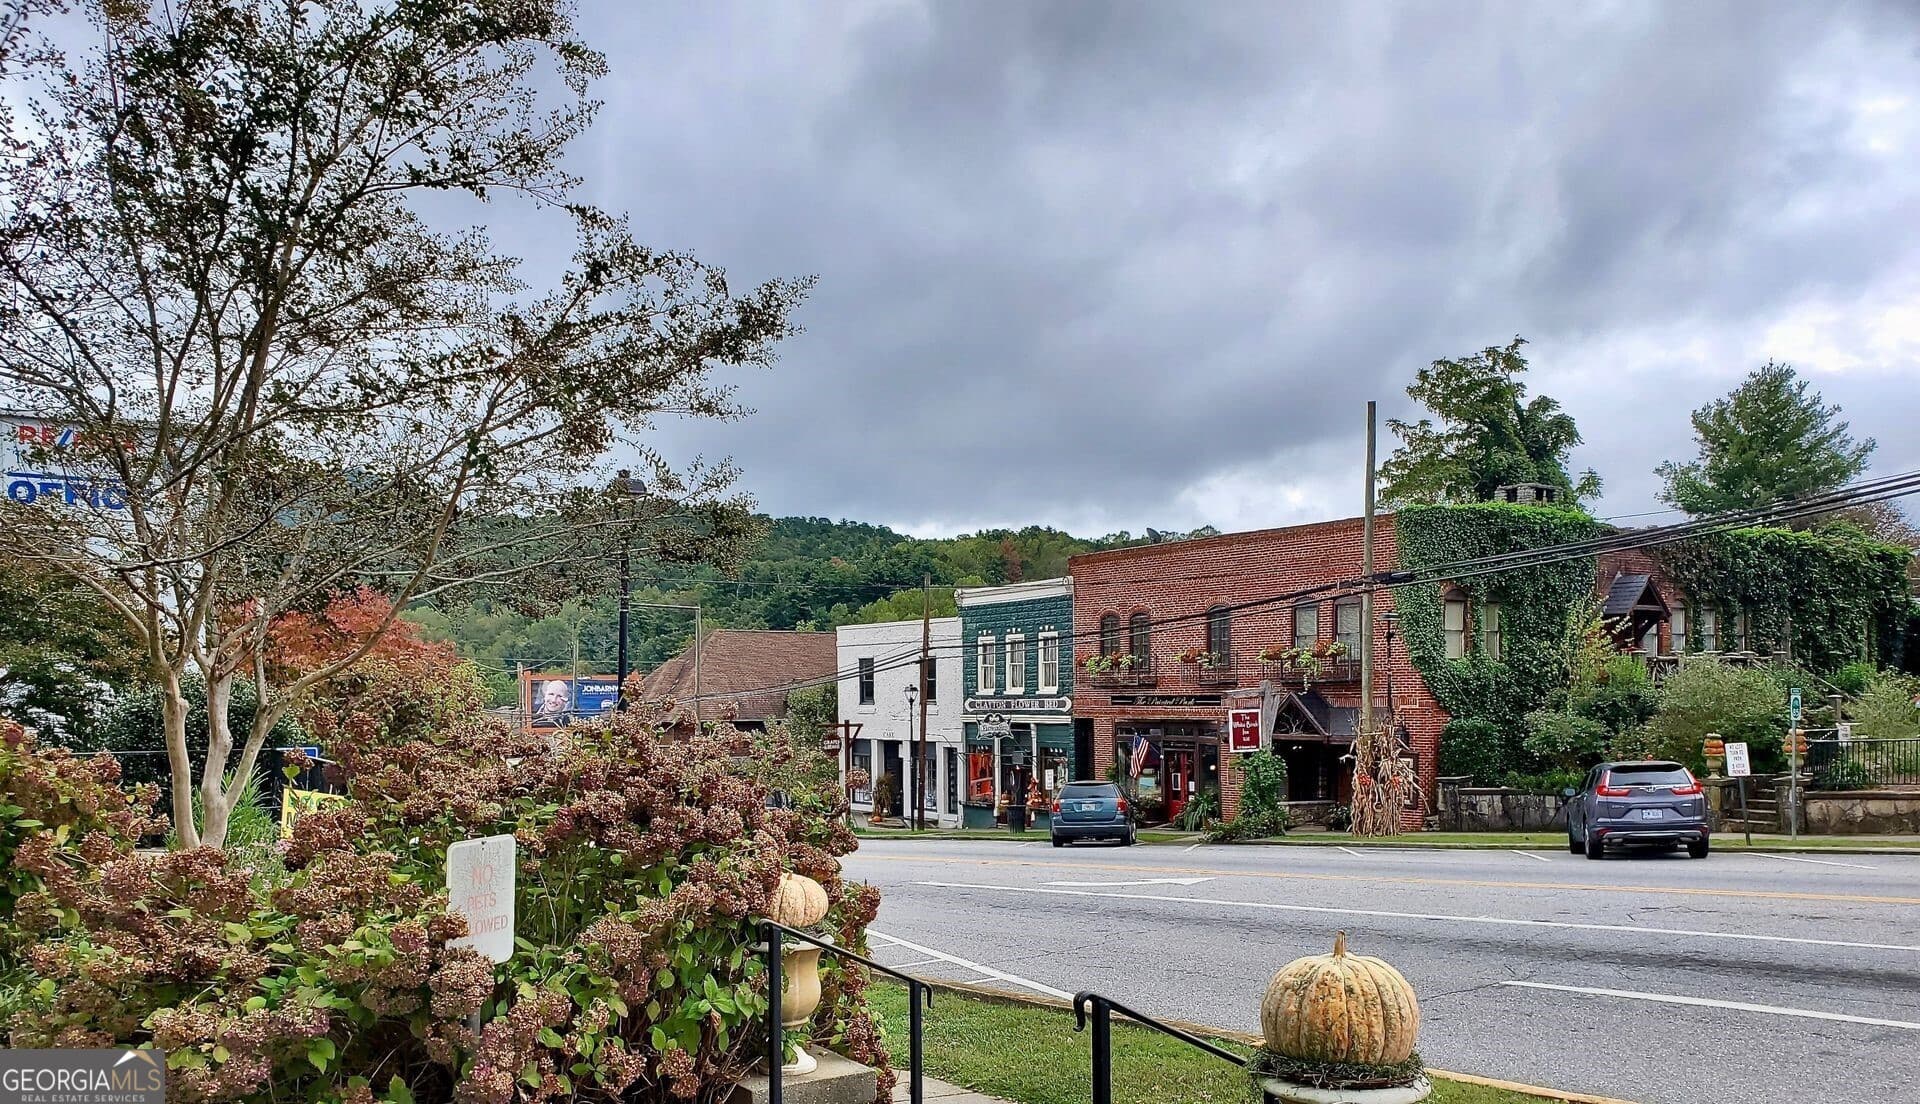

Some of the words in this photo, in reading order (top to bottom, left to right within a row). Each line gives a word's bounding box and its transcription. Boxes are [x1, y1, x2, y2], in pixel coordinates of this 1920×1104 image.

[975, 700, 1006, 709] CLAYTON
[1011, 700, 1040, 709] FLOWER
[1044, 700, 1058, 709] BED
[1240, 713, 1250, 721] The
[471, 864, 494, 885] NO
[467, 892, 497, 912] PETS
